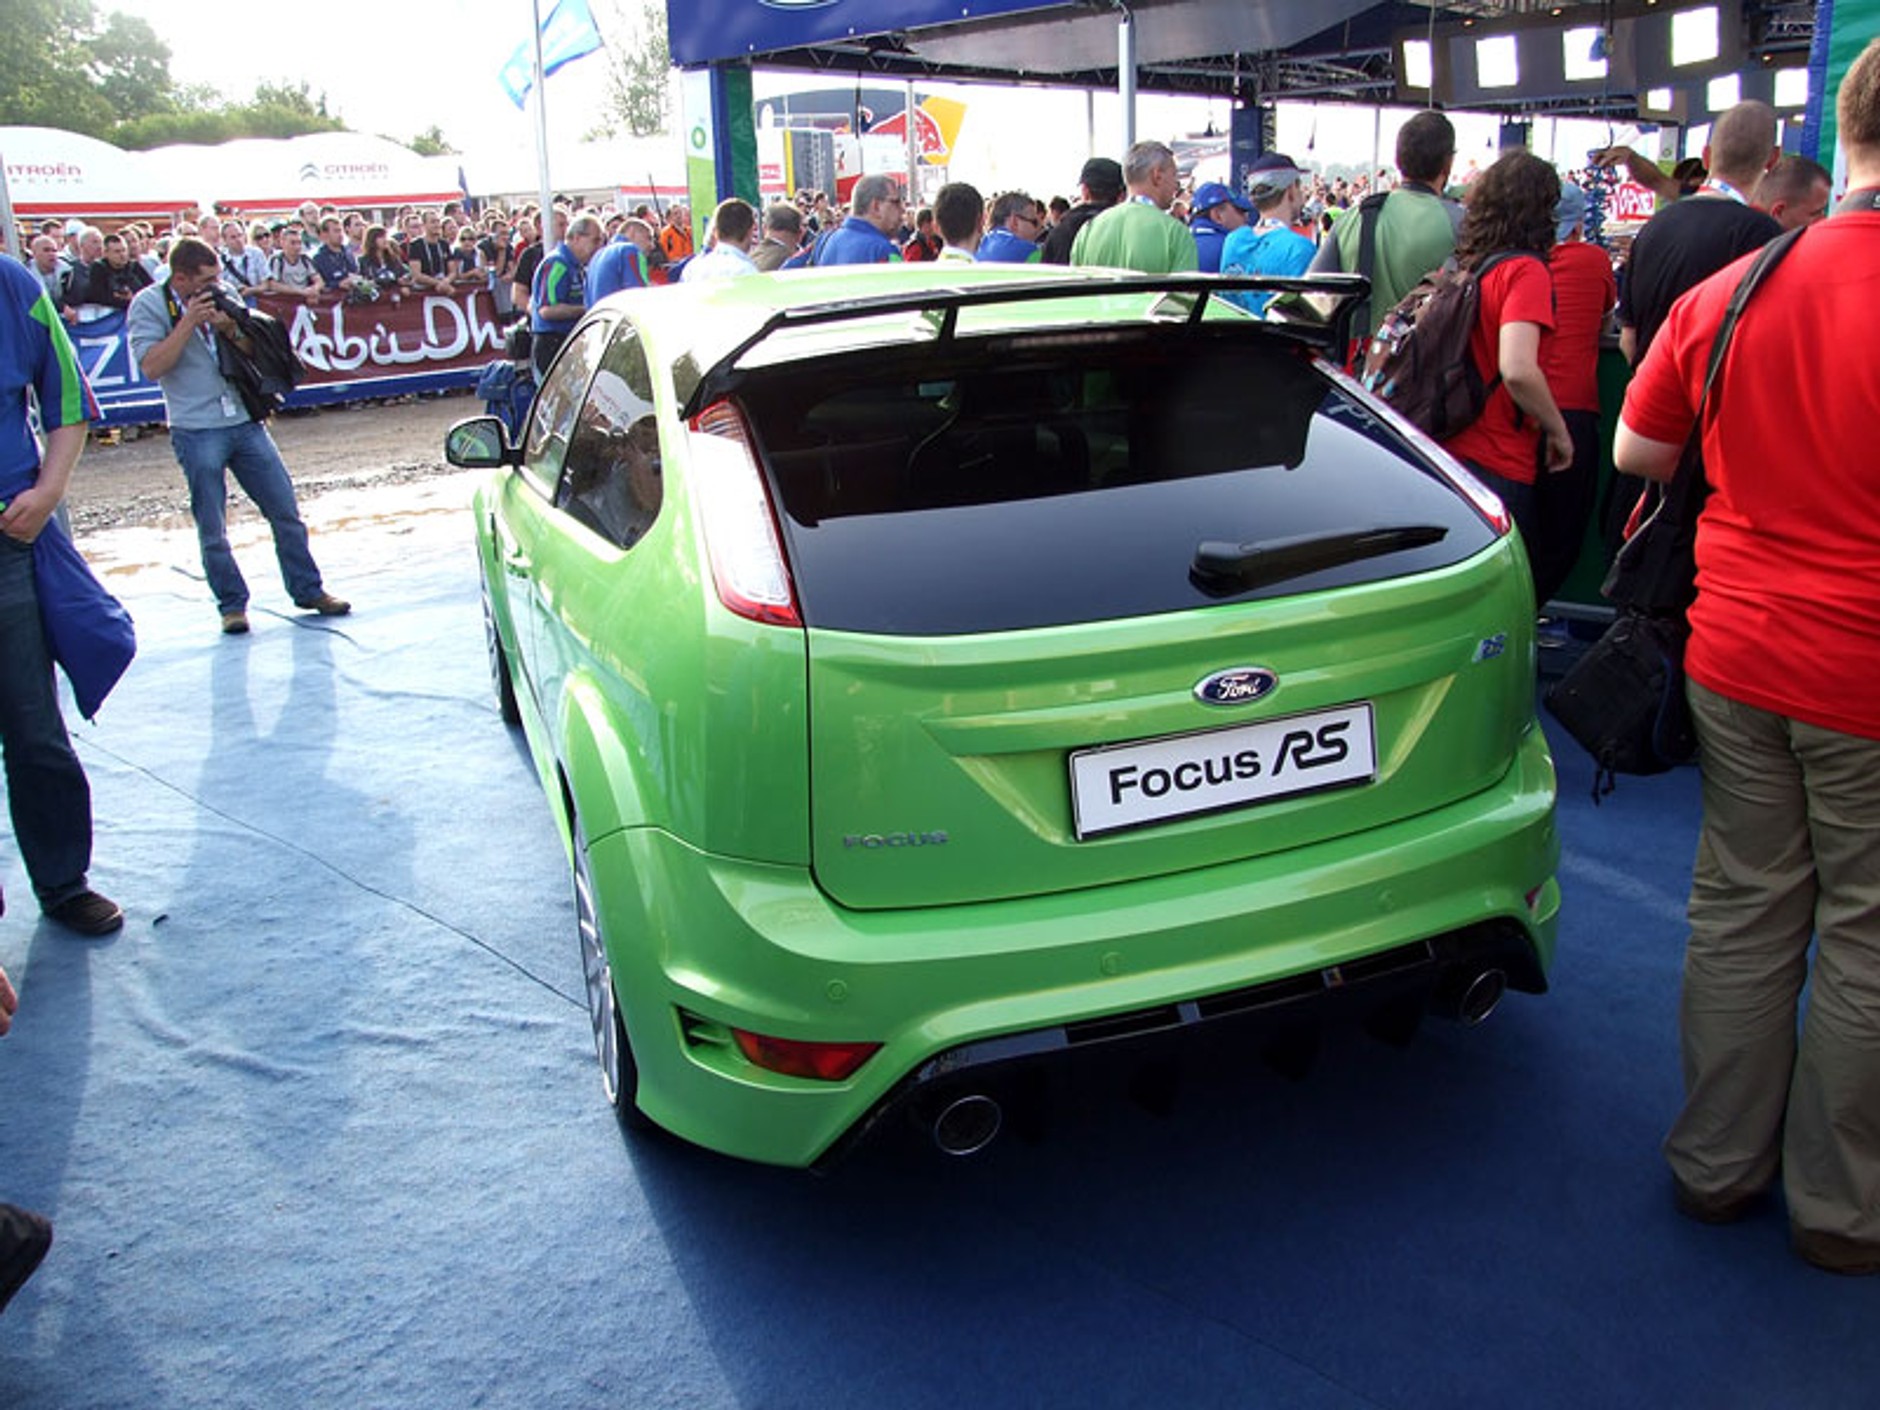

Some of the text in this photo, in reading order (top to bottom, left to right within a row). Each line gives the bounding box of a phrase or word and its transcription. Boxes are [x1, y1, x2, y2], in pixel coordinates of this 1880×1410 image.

[6, 162, 82, 175] ITROËN
[1217, 673, 1261, 699] Ford
[1108, 720, 1350, 805] Focus RS
[843, 829, 949, 849] FOCUS
